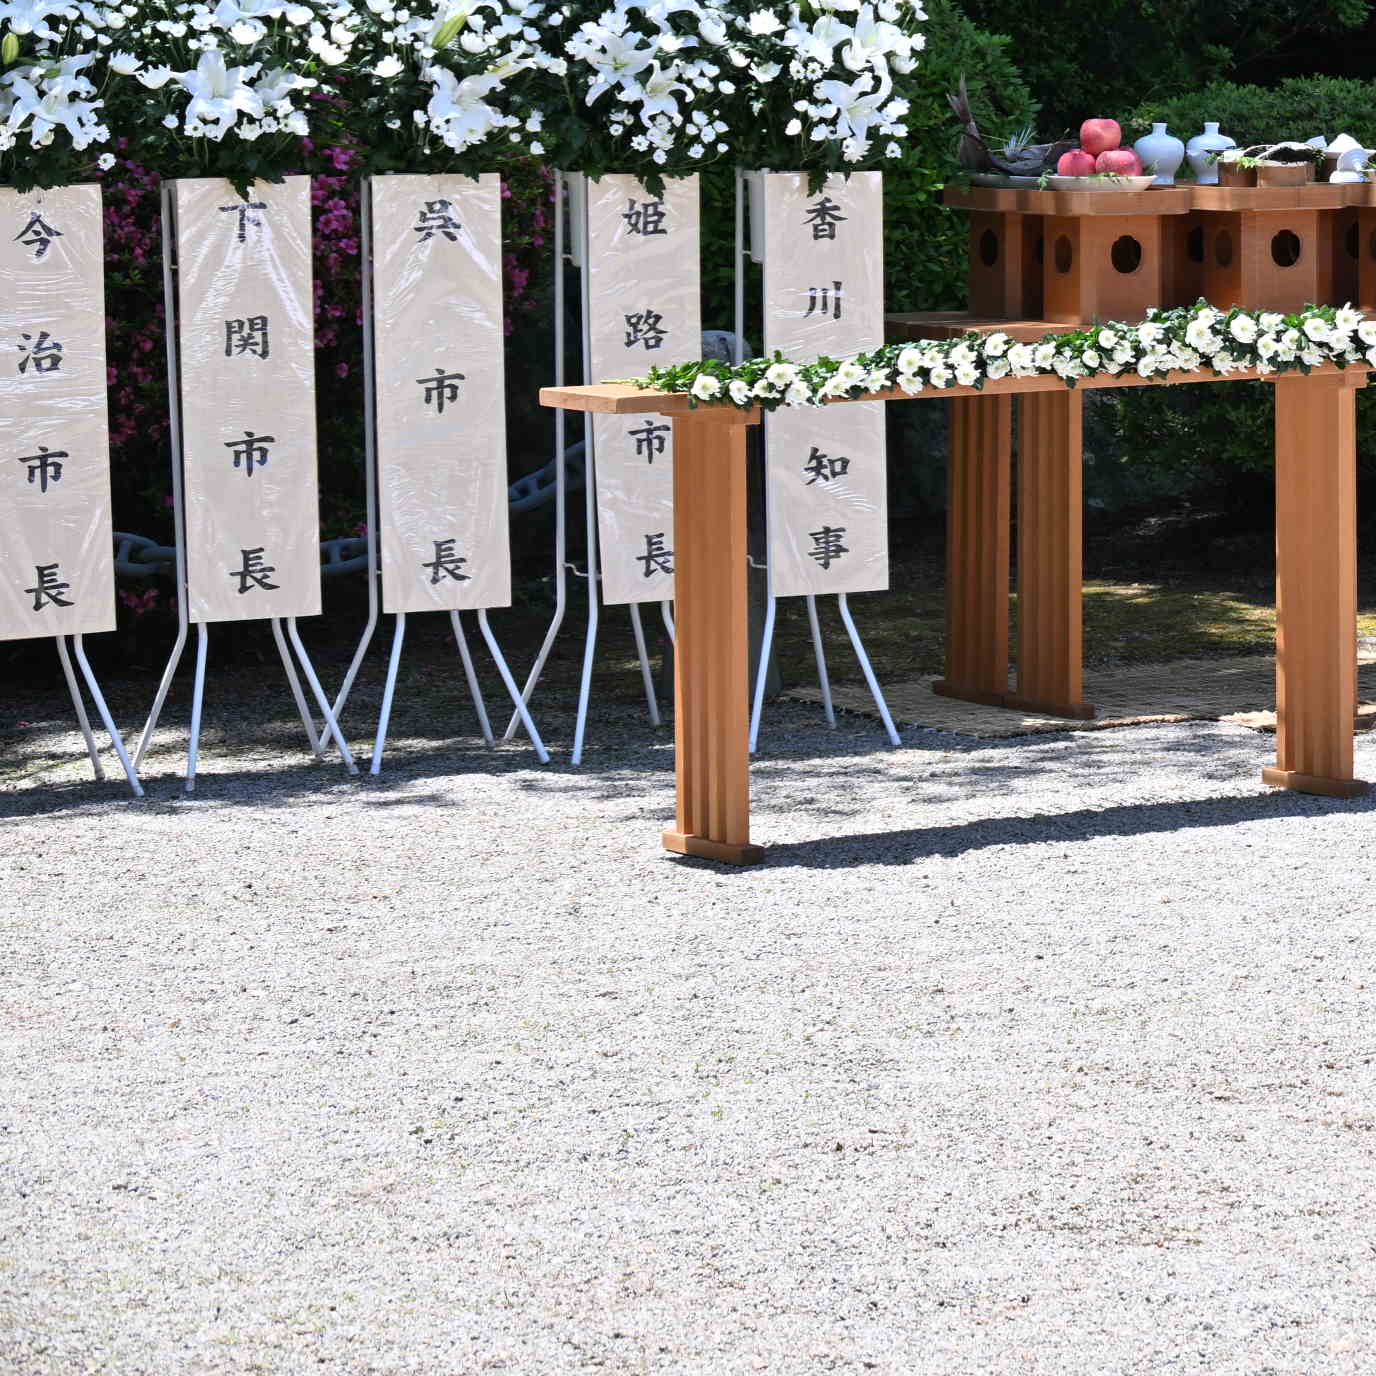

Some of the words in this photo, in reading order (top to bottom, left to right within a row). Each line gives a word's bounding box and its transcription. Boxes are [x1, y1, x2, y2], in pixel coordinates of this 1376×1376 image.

[13, 210, 75, 612] 今治市長
[218, 201, 281, 594] 下関市長
[413, 199, 471, 586] 呉市長
[622, 197, 673, 578] 姫路市長
[802, 197, 850, 571] 香川知事
